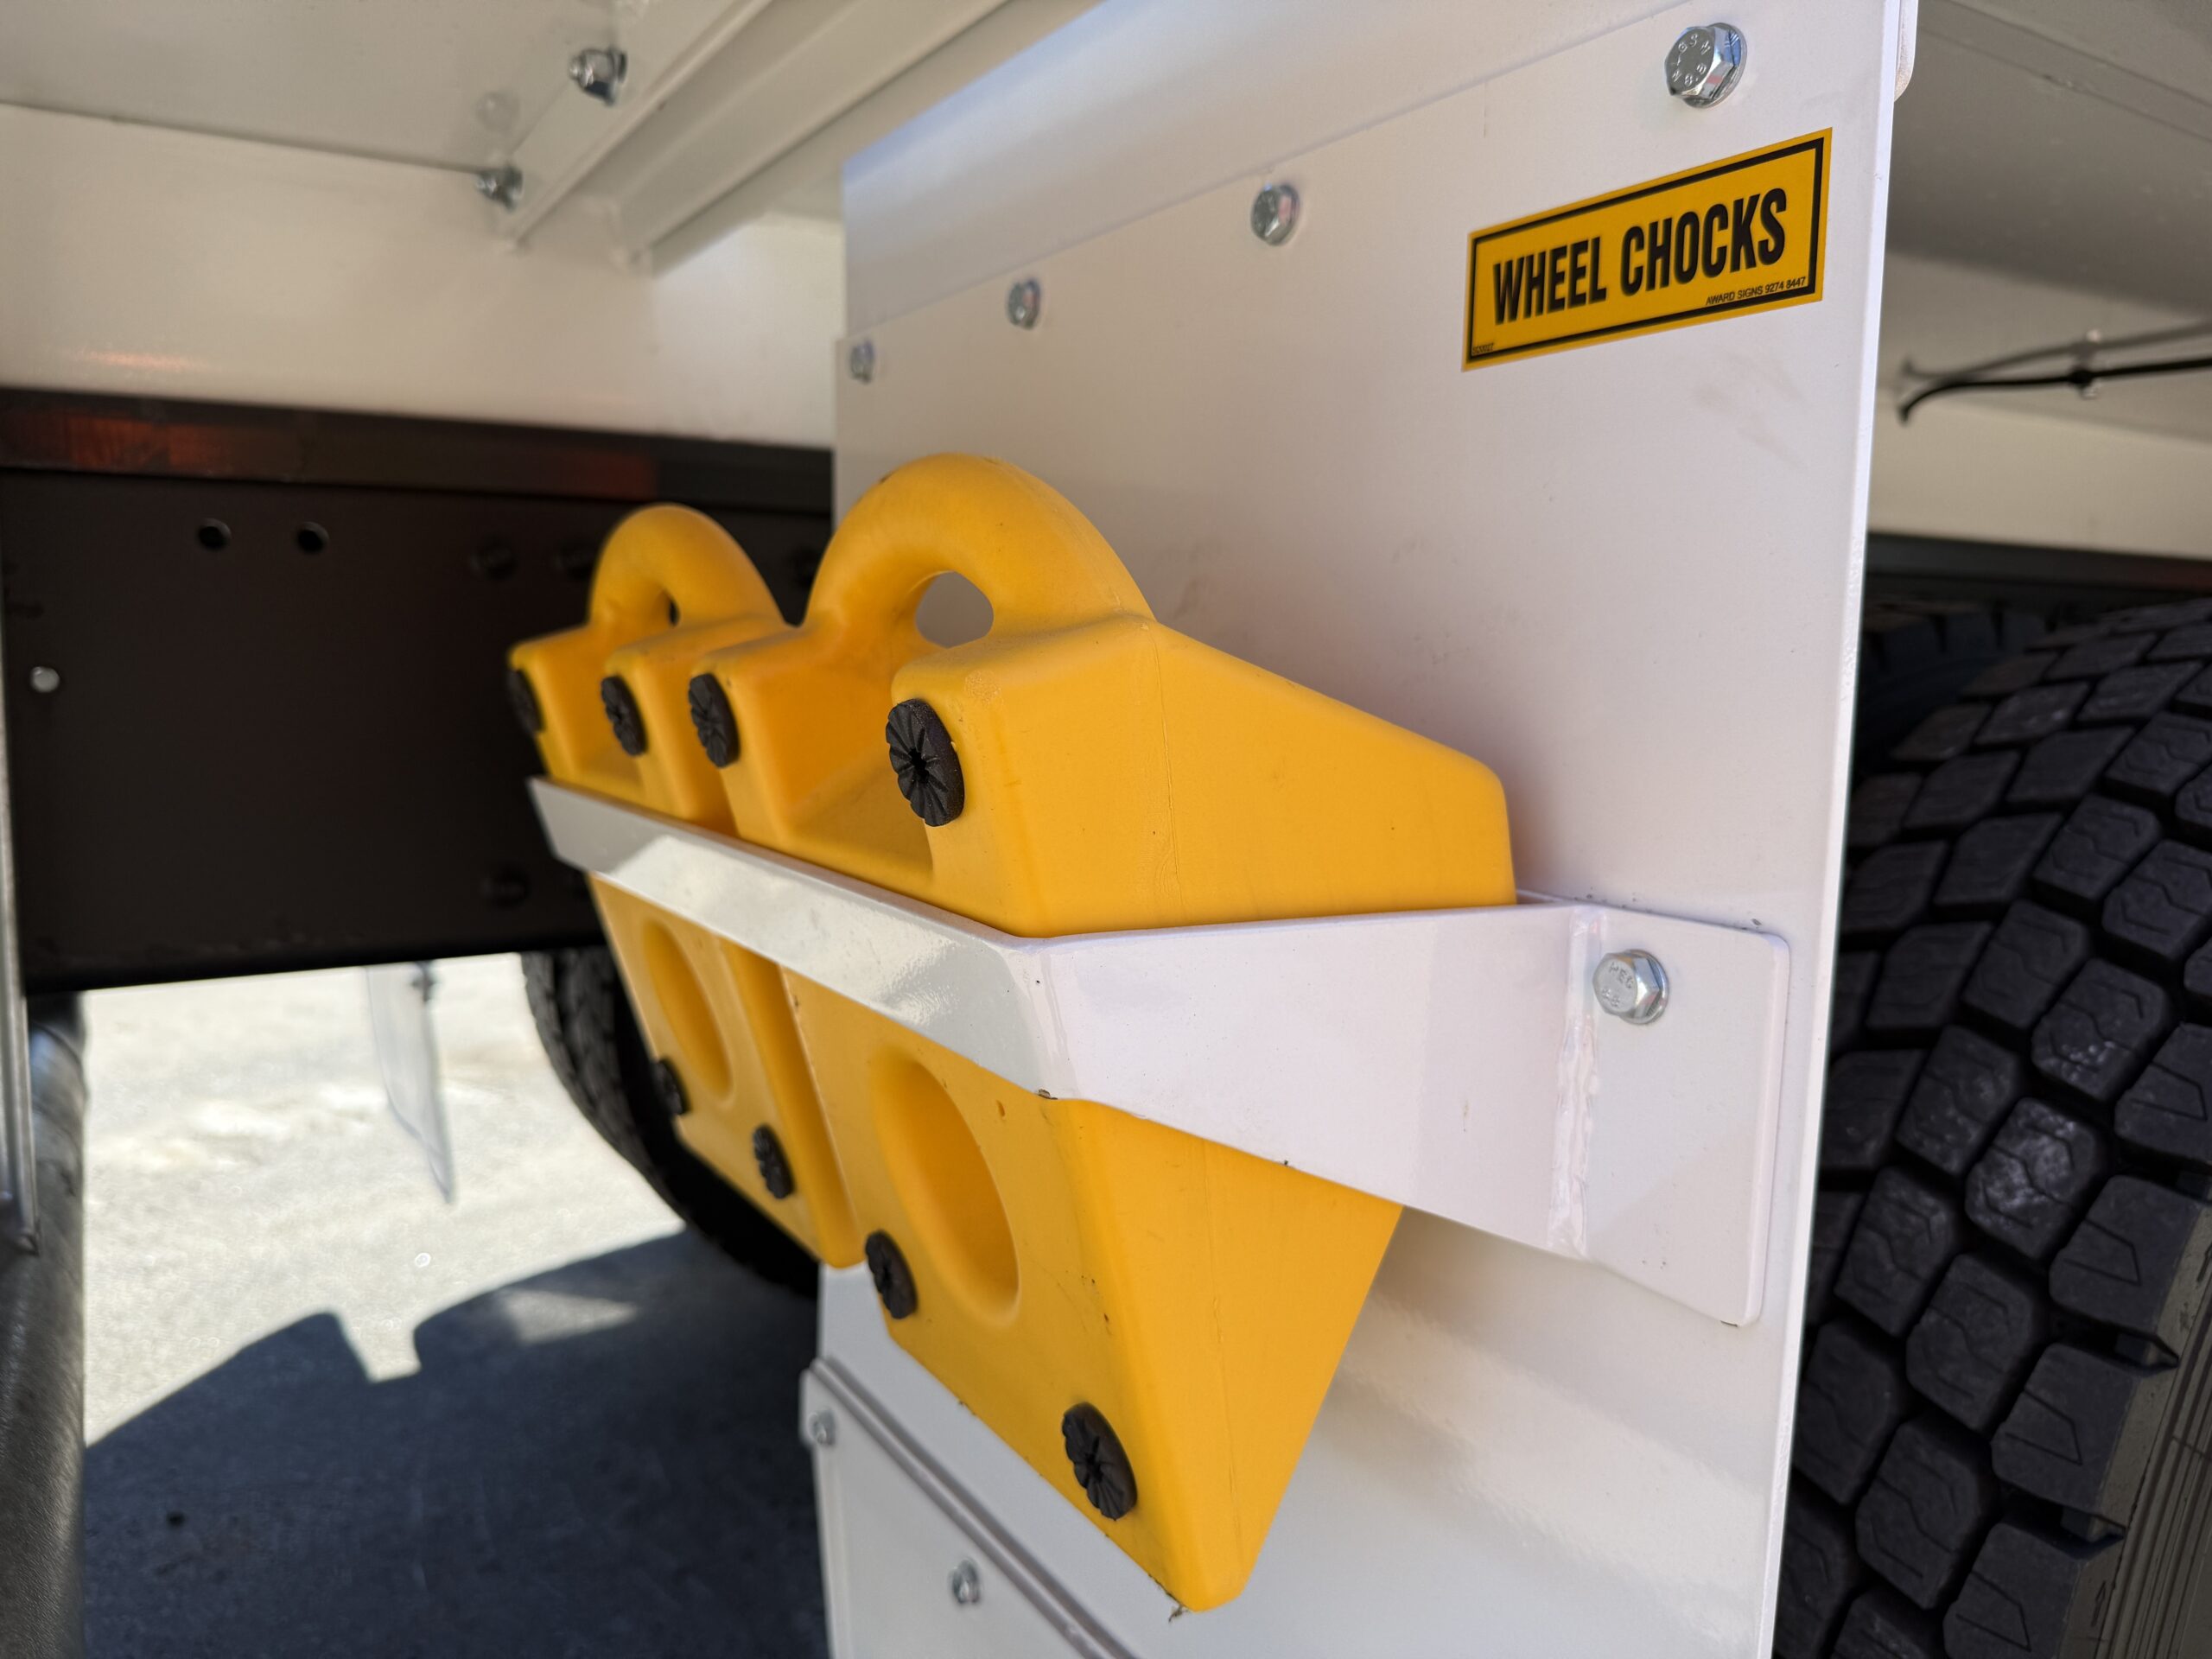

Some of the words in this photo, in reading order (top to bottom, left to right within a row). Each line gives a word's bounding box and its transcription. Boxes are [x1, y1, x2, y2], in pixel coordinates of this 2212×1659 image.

[1492, 237, 1607, 326] WHEEL
[1619, 188, 1787, 297] CHOCKS
[1706, 292, 1735, 305] AWARD
[1737, 286, 1764, 299] SIGNS
[1765, 282, 1784, 294] 9274
[1786, 276, 1806, 289] 8447
